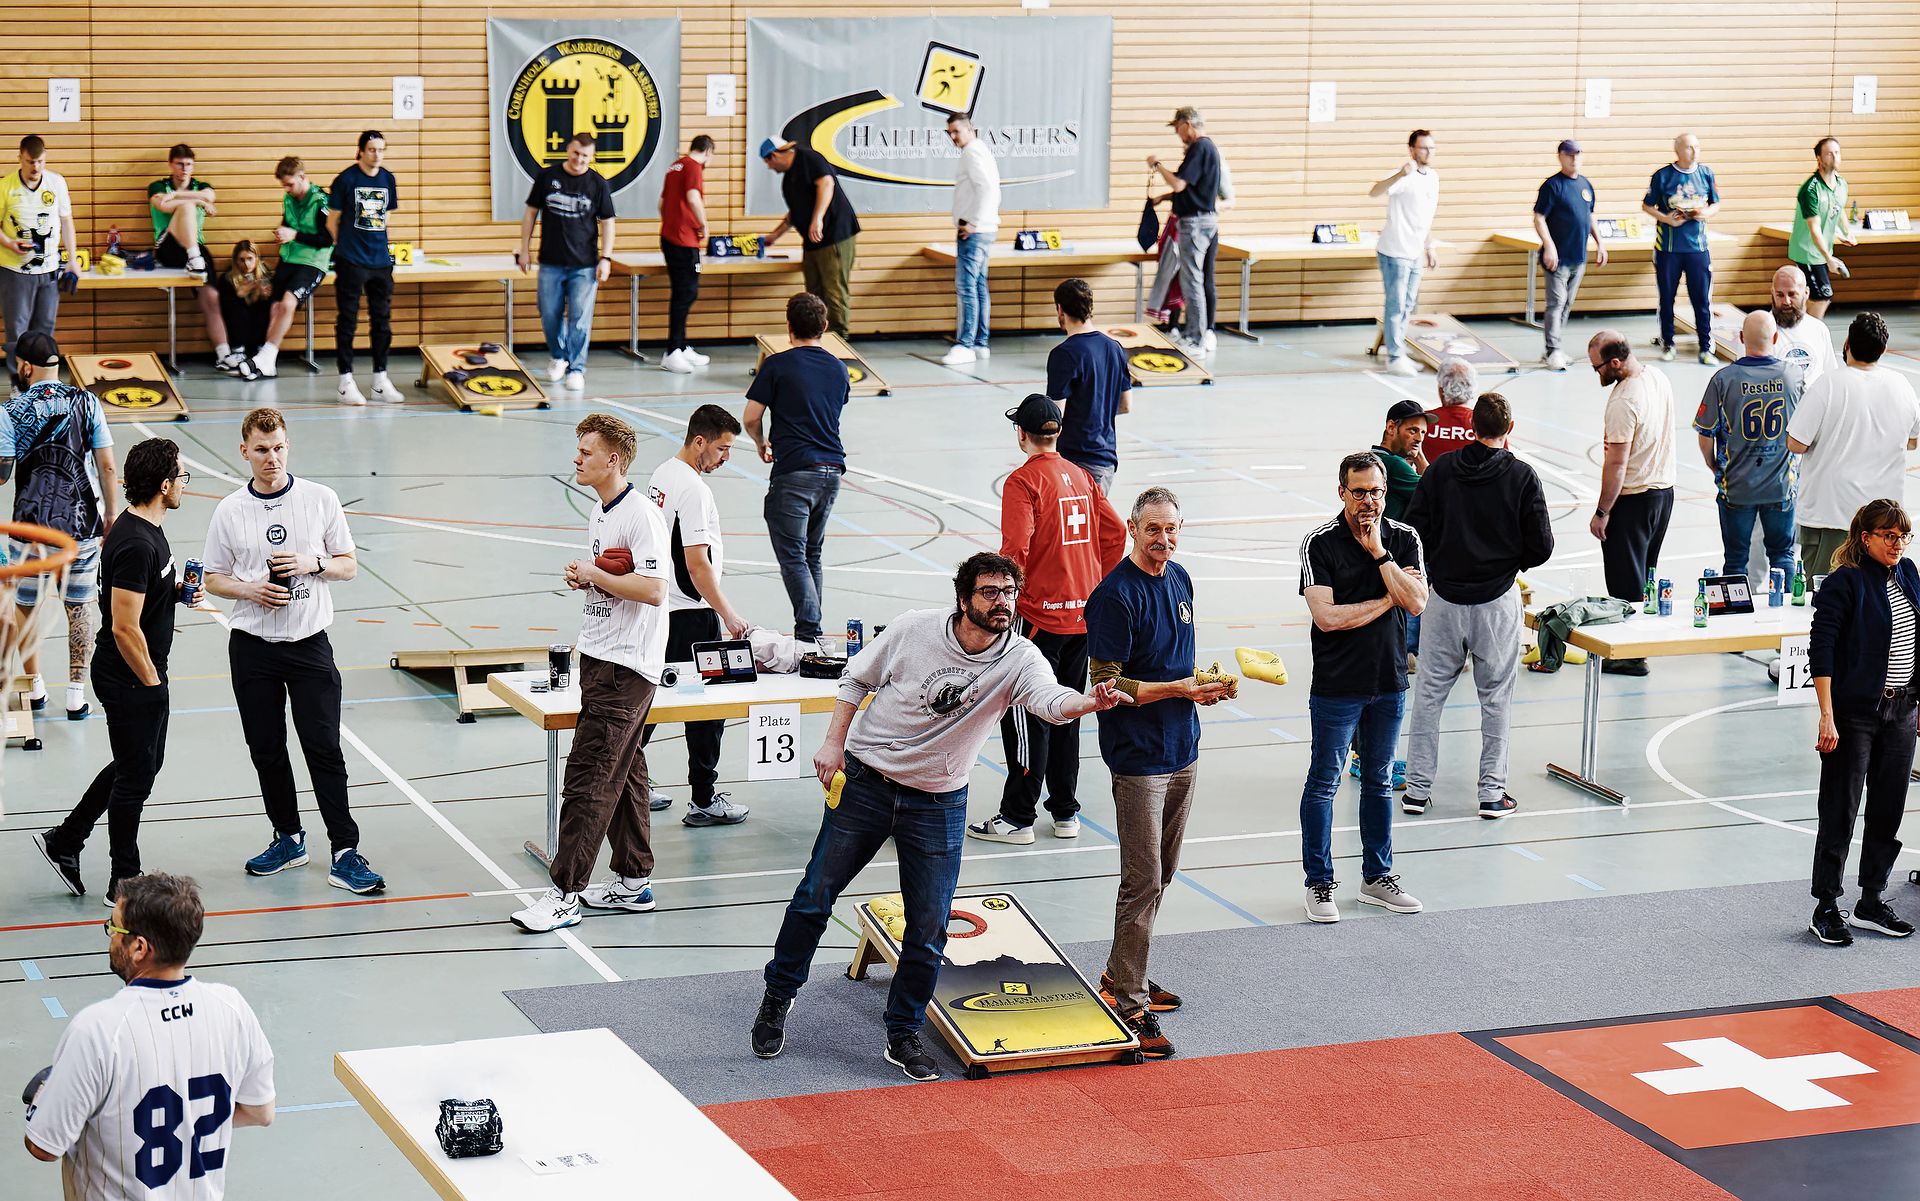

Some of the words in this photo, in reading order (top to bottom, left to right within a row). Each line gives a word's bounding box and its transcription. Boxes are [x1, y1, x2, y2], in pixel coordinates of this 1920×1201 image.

[555, 40, 623, 61] WARRIORS
[60, 96, 70, 112] 7
[403, 94, 414, 111] 6
[850, 120, 1080, 147] HALLENASTERS
[401, 248, 409, 262] 2
[1741, 379, 1783, 395] Peschä
[1741, 398, 1785, 441] 66
[289, 588, 310, 601] ARDS
[1734, 588, 1744, 597] 10
[736, 654, 743, 664] 8
[1789, 646, 1806, 657] Pla
[706, 656, 713, 665] 2
[920, 666, 967, 690] UNIVERSITY
[759, 715, 791, 727] Platz
[756, 733, 795, 764] 13
[979, 990, 1085, 1006] HALLENMASTERS
[160, 1002, 193, 1022] CCW
[133, 1072, 232, 1190] 82
